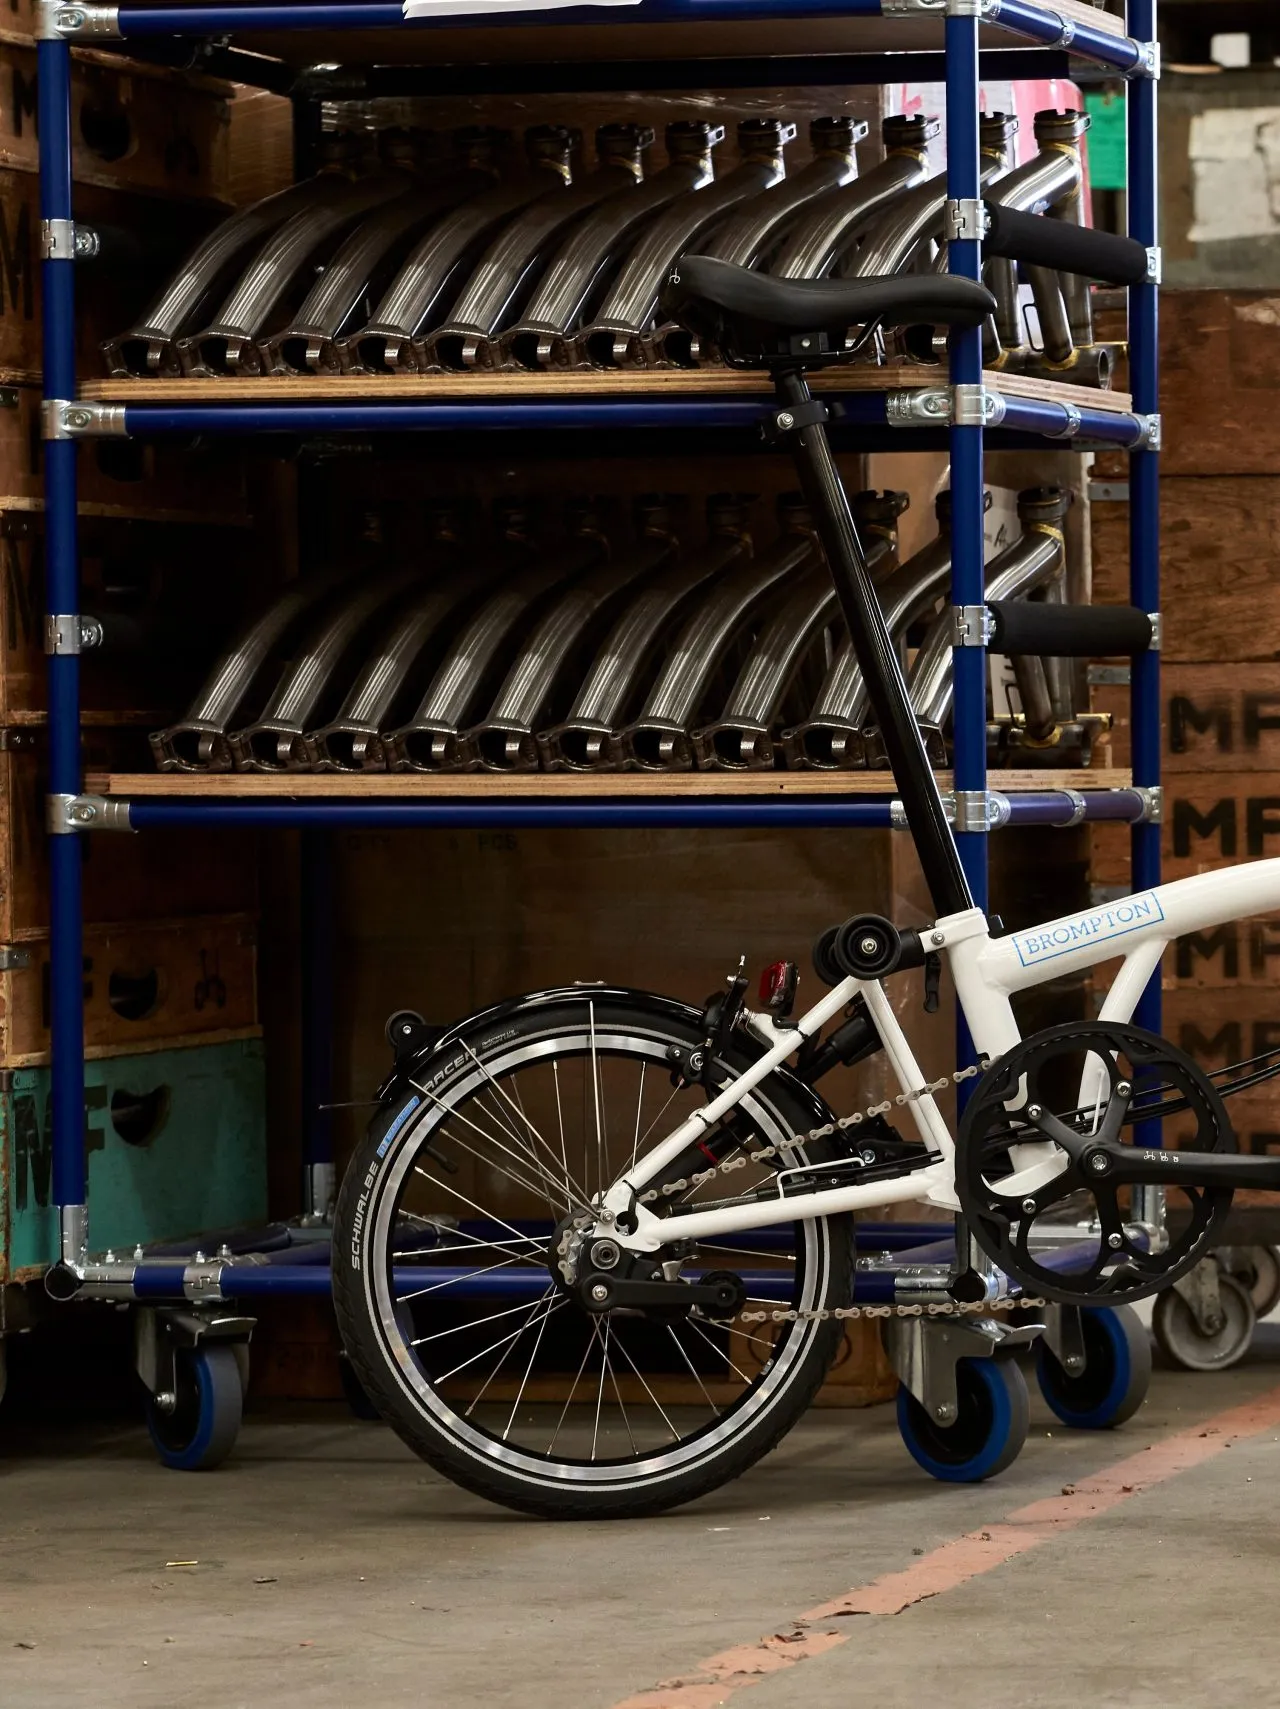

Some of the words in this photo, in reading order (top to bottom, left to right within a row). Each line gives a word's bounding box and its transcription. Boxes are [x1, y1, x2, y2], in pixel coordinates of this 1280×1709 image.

[1025, 899, 1151, 954] BROMPTON
[351, 1160, 380, 1271] SCHWALBE
[422, 1047, 477, 1092] RACER
